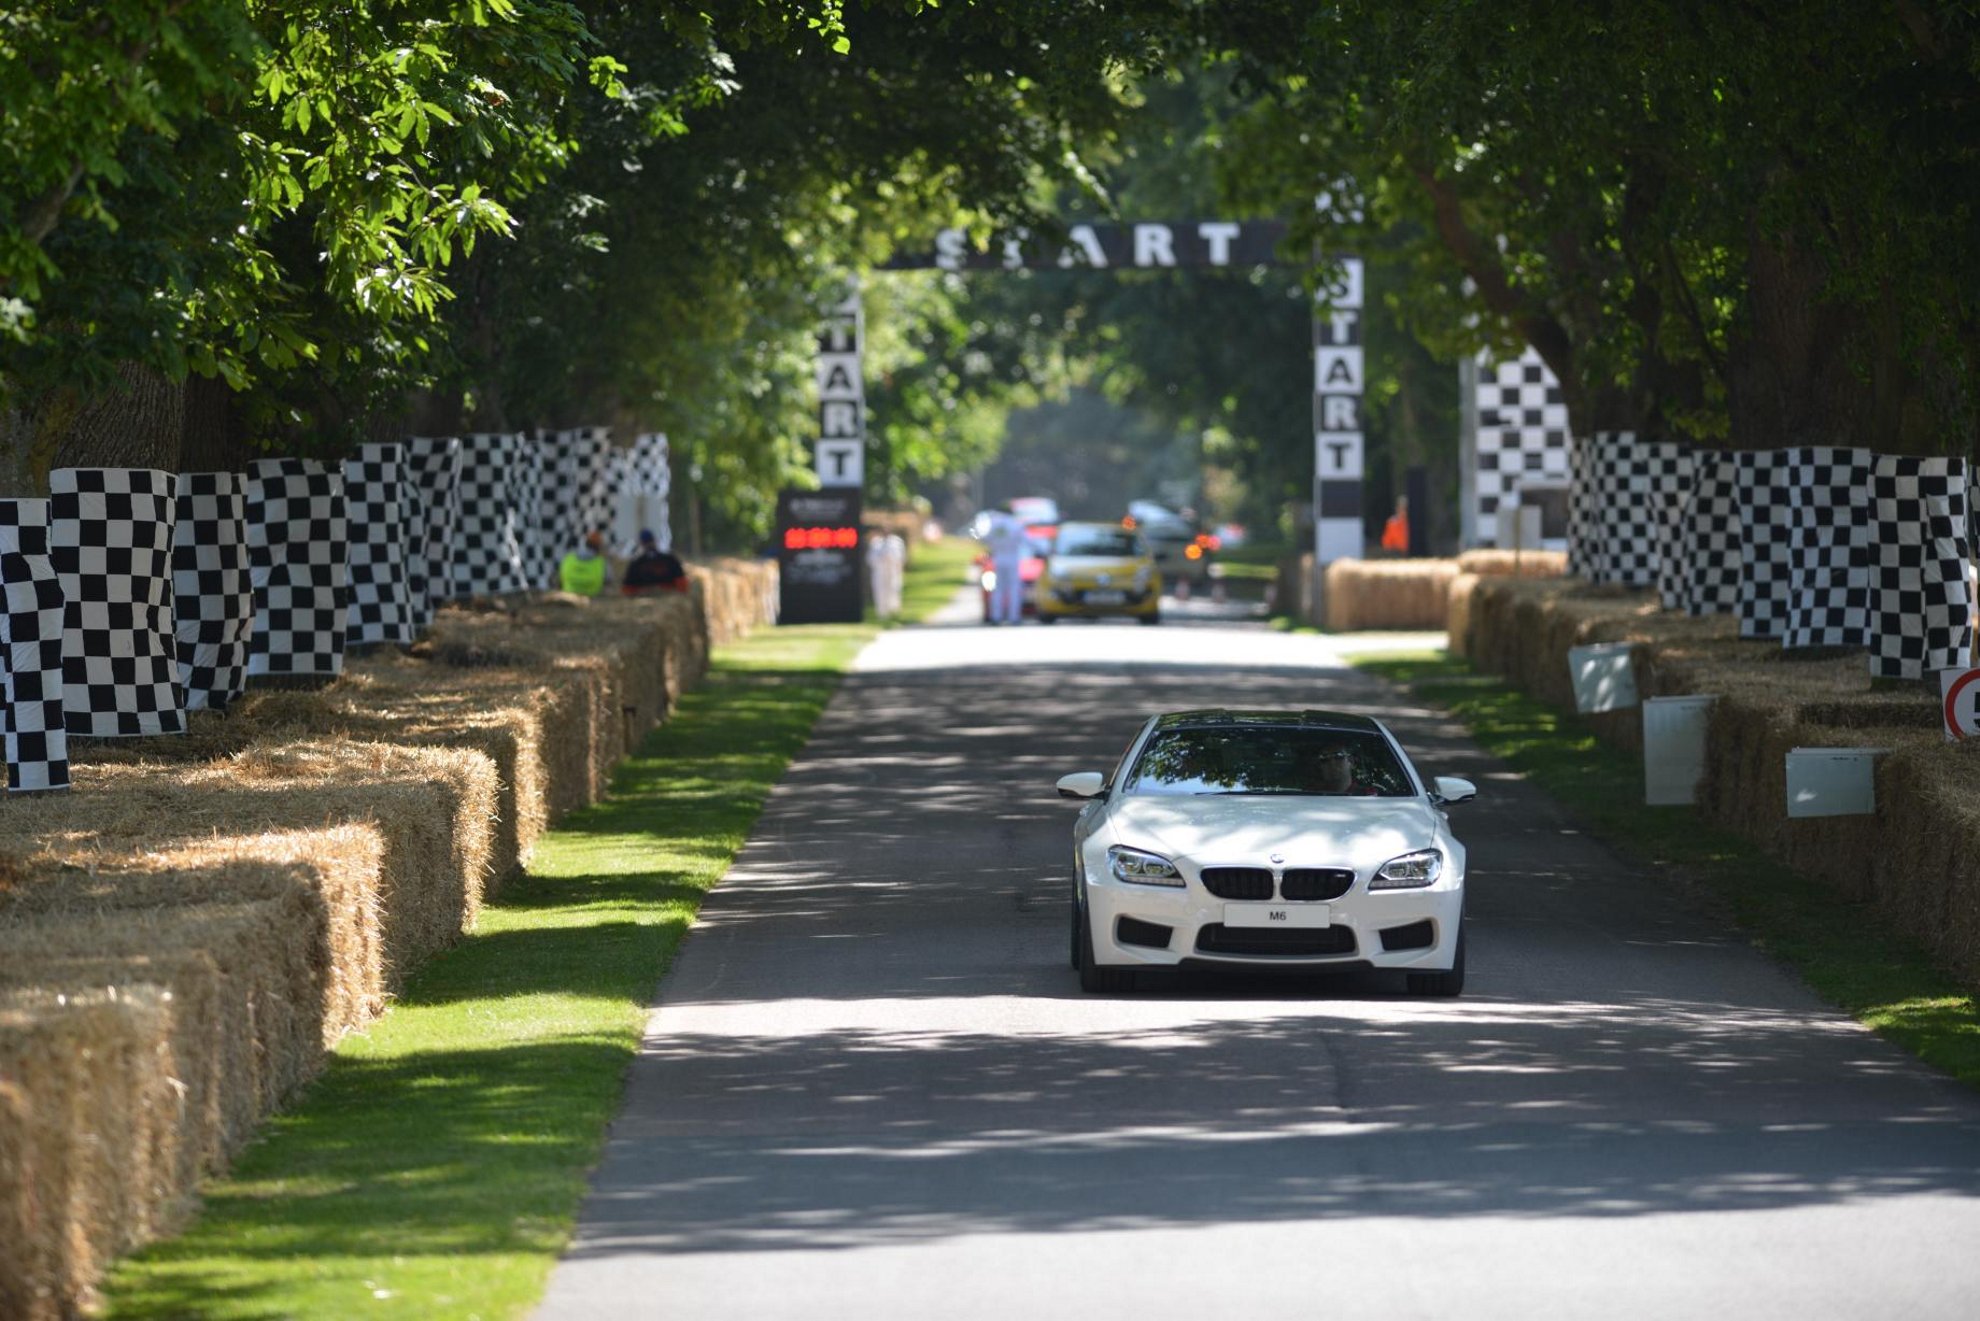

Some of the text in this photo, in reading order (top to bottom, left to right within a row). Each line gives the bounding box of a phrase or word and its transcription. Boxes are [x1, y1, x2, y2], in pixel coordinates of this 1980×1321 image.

[936, 222, 1240, 270] START
[821, 287, 855, 477] TART
[1269, 911, 1287, 921] M6
